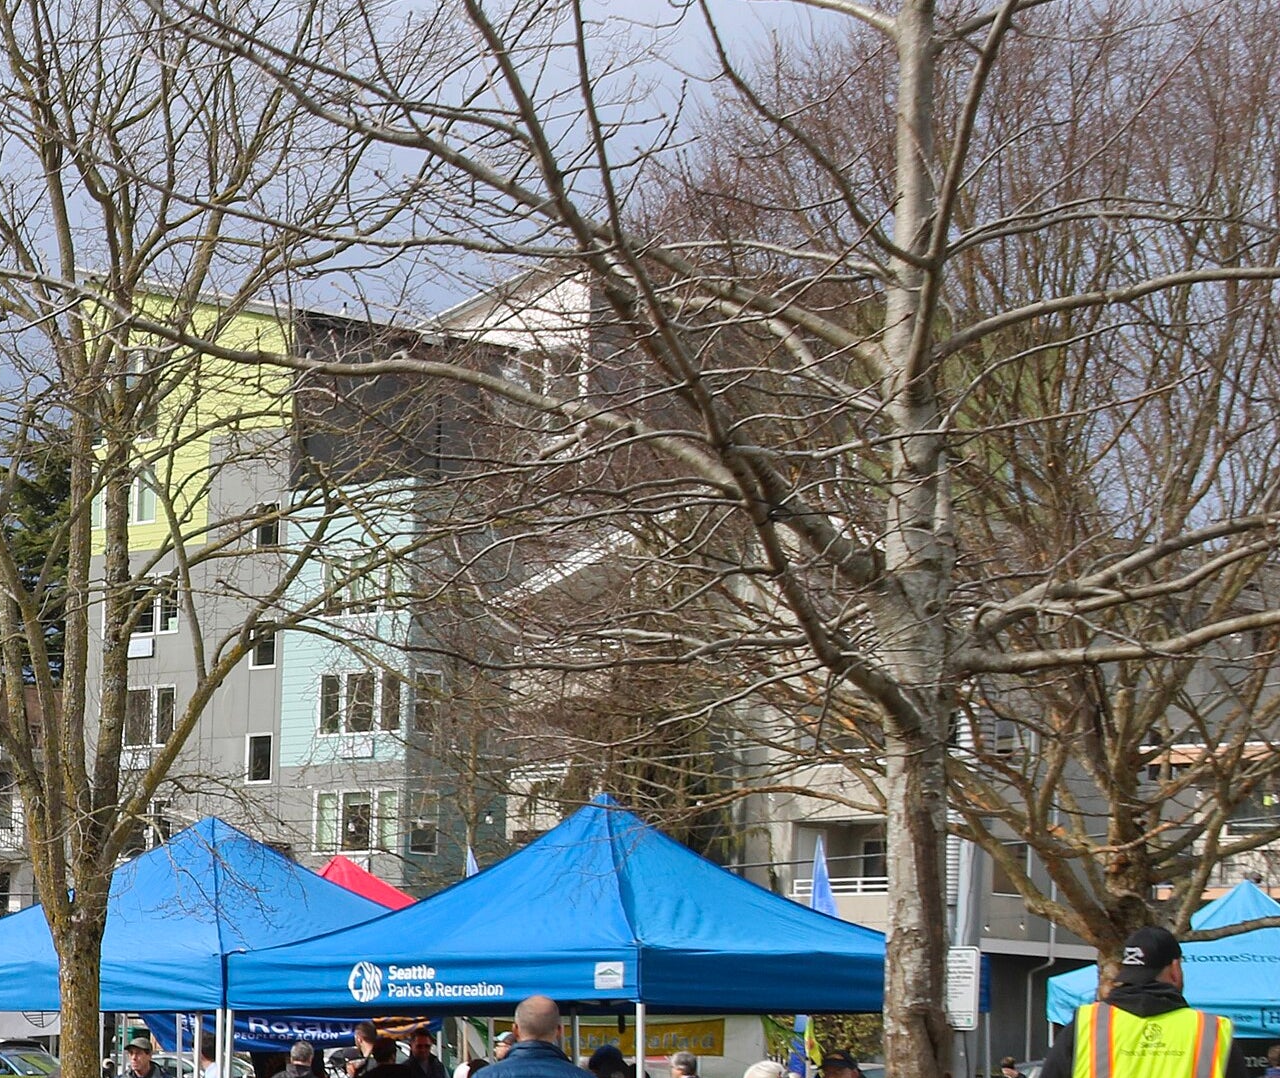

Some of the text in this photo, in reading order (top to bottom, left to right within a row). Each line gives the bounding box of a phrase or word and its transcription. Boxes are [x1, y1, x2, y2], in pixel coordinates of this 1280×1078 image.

[388, 964, 435, 981] Seattle
[388, 981, 503, 998] Parks & Recreation
[248, 1016, 353, 1036] Rotary
[233, 1031, 339, 1041] PEOPLE OF ACTION
